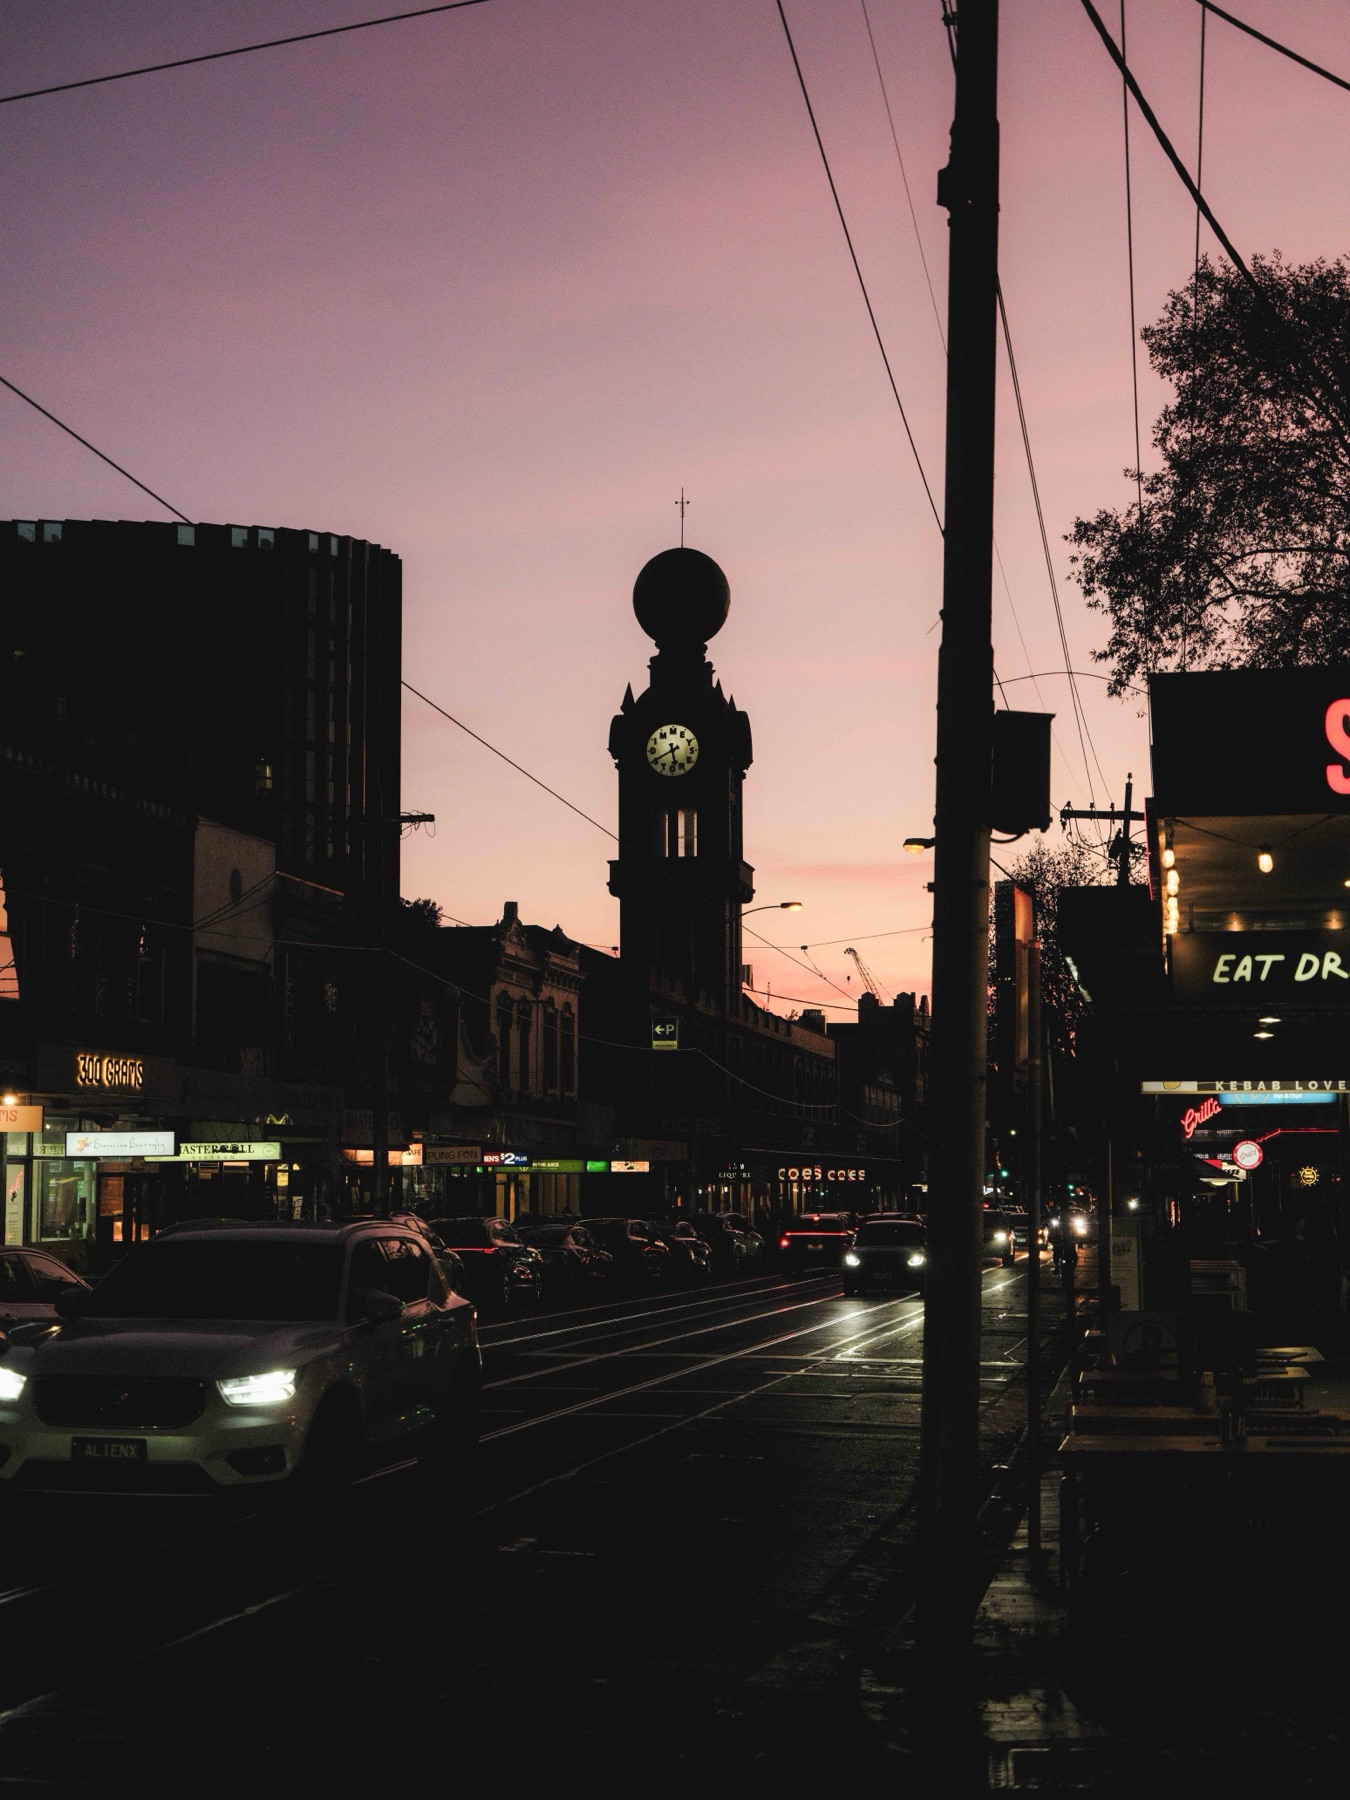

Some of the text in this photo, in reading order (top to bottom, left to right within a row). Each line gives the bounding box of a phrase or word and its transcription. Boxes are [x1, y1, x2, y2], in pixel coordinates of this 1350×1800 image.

[1212, 954, 1285, 983] EAT
[666, 1024, 675, 1035] P
[78, 1055, 144, 1089] 300 GRAMS
[1216, 1081, 1346, 1091] KEBAB LOVE
[85, 1443, 137, 1458] ALIENX
